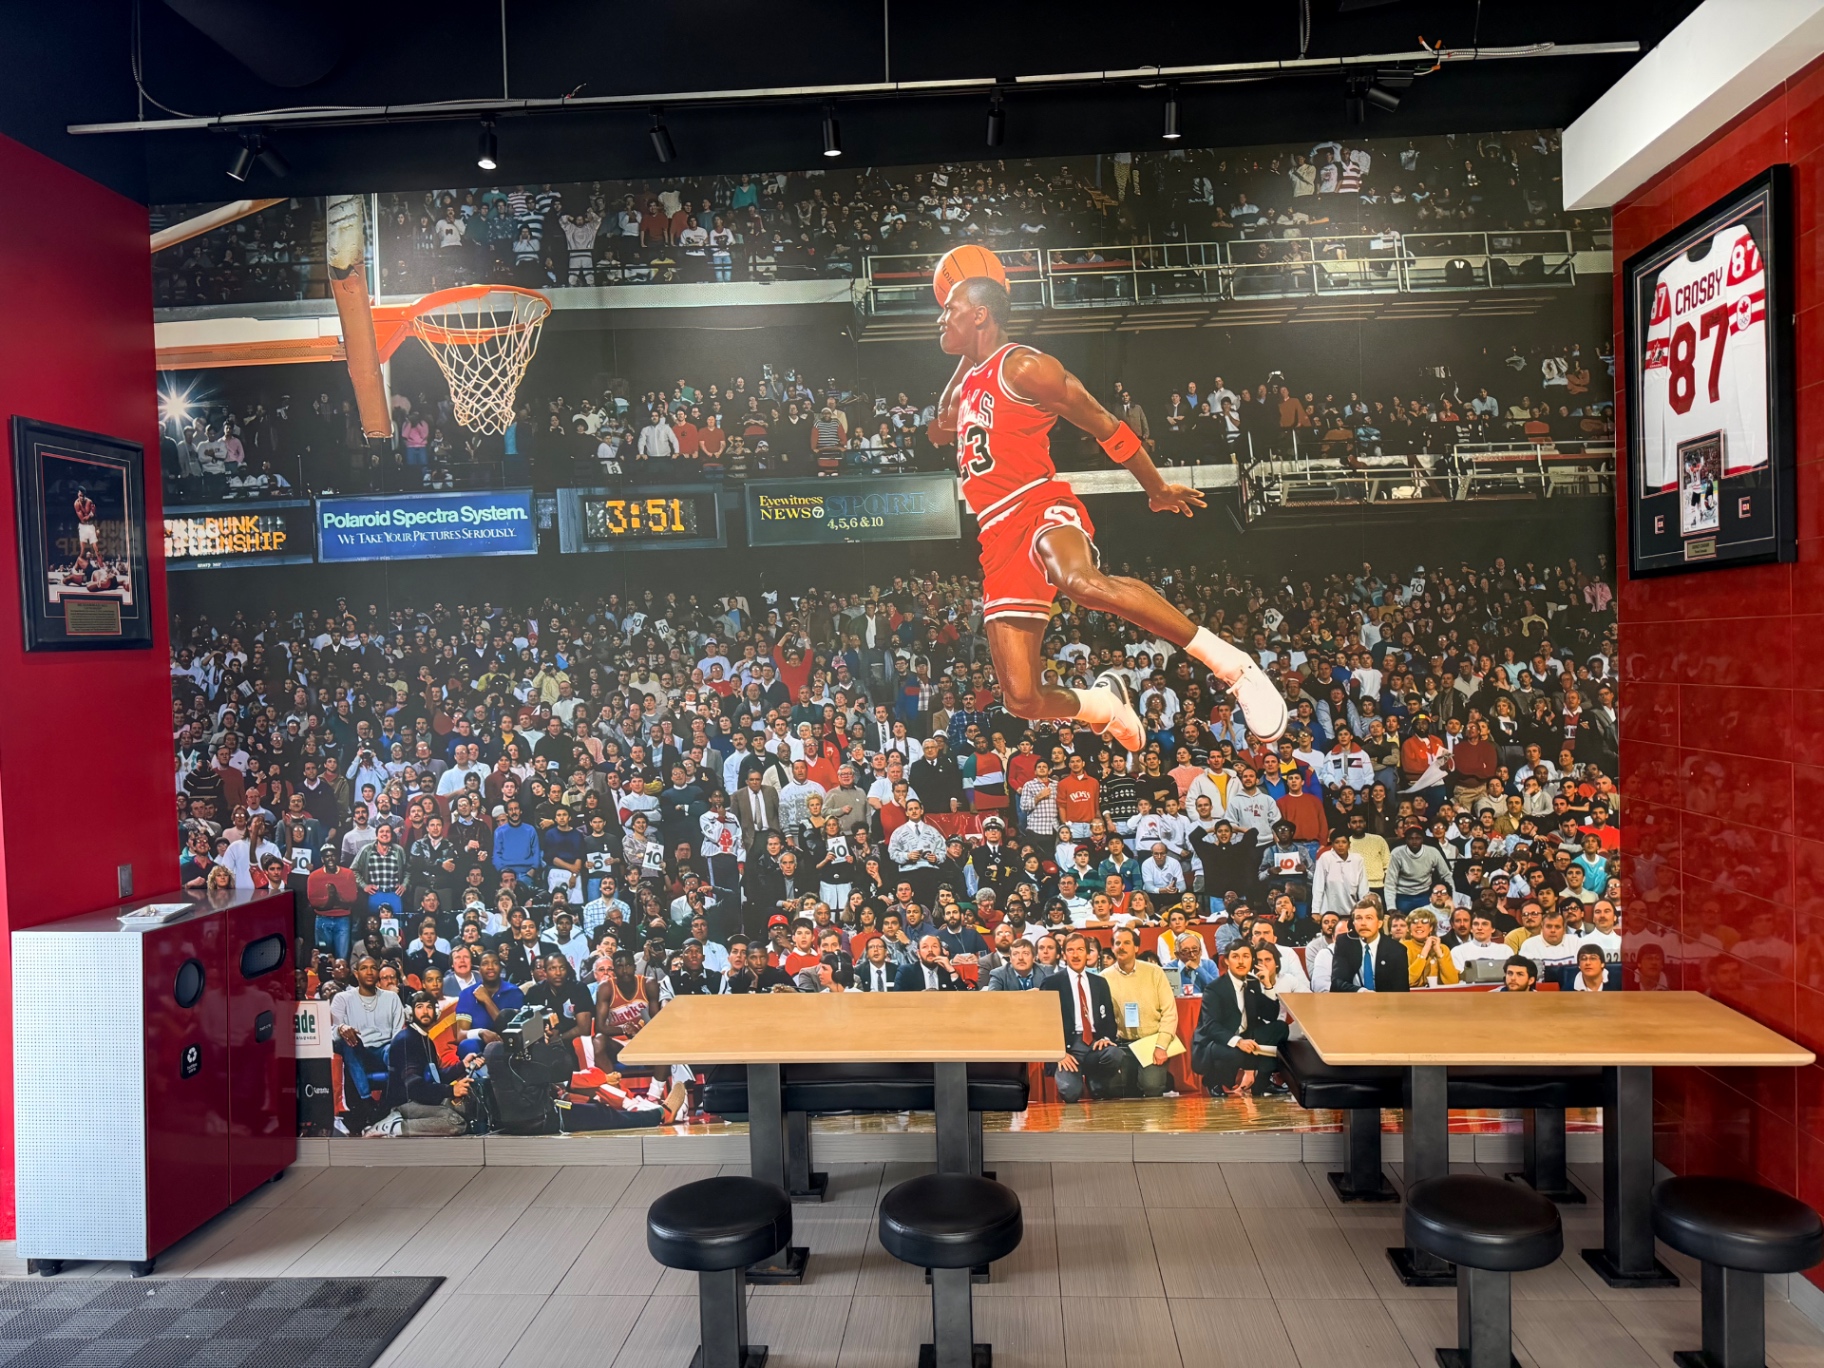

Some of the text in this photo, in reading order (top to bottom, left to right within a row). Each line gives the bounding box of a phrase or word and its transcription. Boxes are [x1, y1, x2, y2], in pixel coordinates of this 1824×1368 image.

[1732, 239, 1760, 279] 87
[1676, 266, 1723, 316] CROSBY
[1669, 303, 1729, 415] 87
[759, 494, 823, 507] Eyewitness
[761, 506, 825, 520] NEWS 7
[323, 504, 528, 529] Polaroid Spectra System.
[606, 498, 686, 533] 3:51
[860, 517, 871, 528] &
[871, 516, 884, 527] 10
[645, 850, 662, 866] 10
